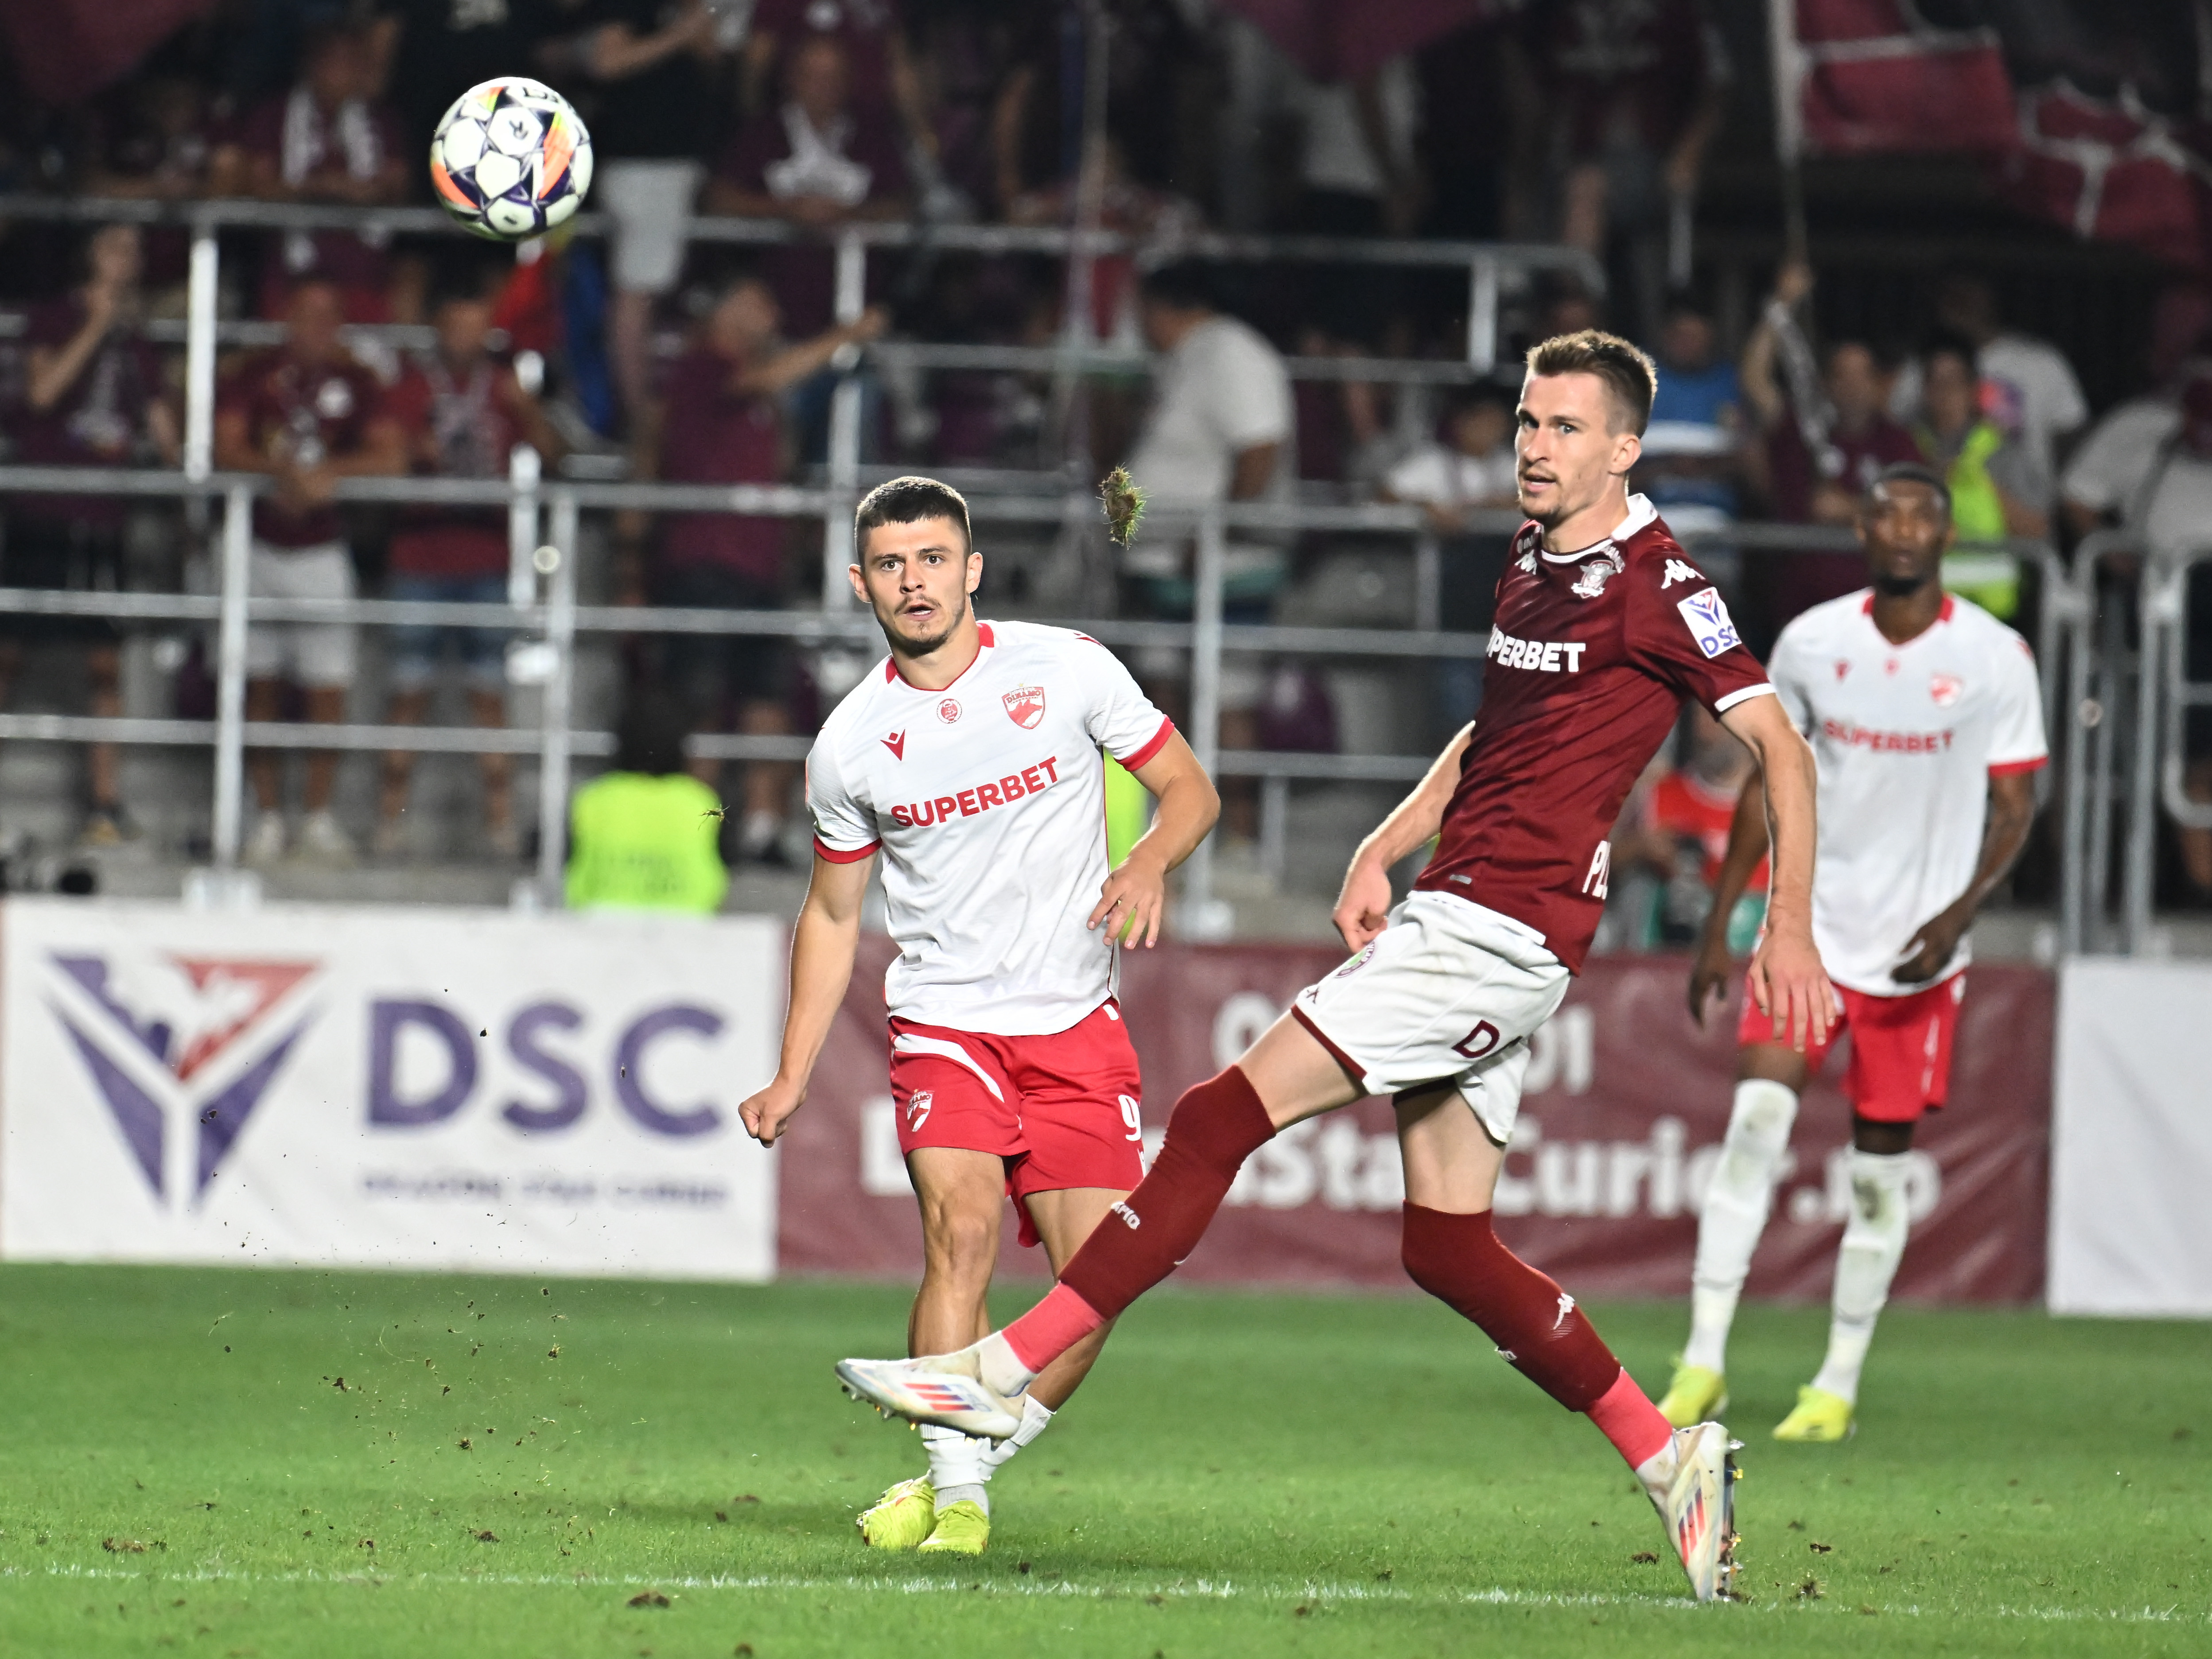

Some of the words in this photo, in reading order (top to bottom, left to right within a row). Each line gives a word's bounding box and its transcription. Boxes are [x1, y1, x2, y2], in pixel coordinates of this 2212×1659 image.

[1486, 623, 1586, 672] PERBET
[1006, 690, 1041, 703] DINAMO
[1823, 719, 1954, 752] SUPERBET
[891, 756, 1057, 827] SUPERBET
[367, 998, 727, 1138] DSC
[1118, 1094, 1142, 1142] 9
